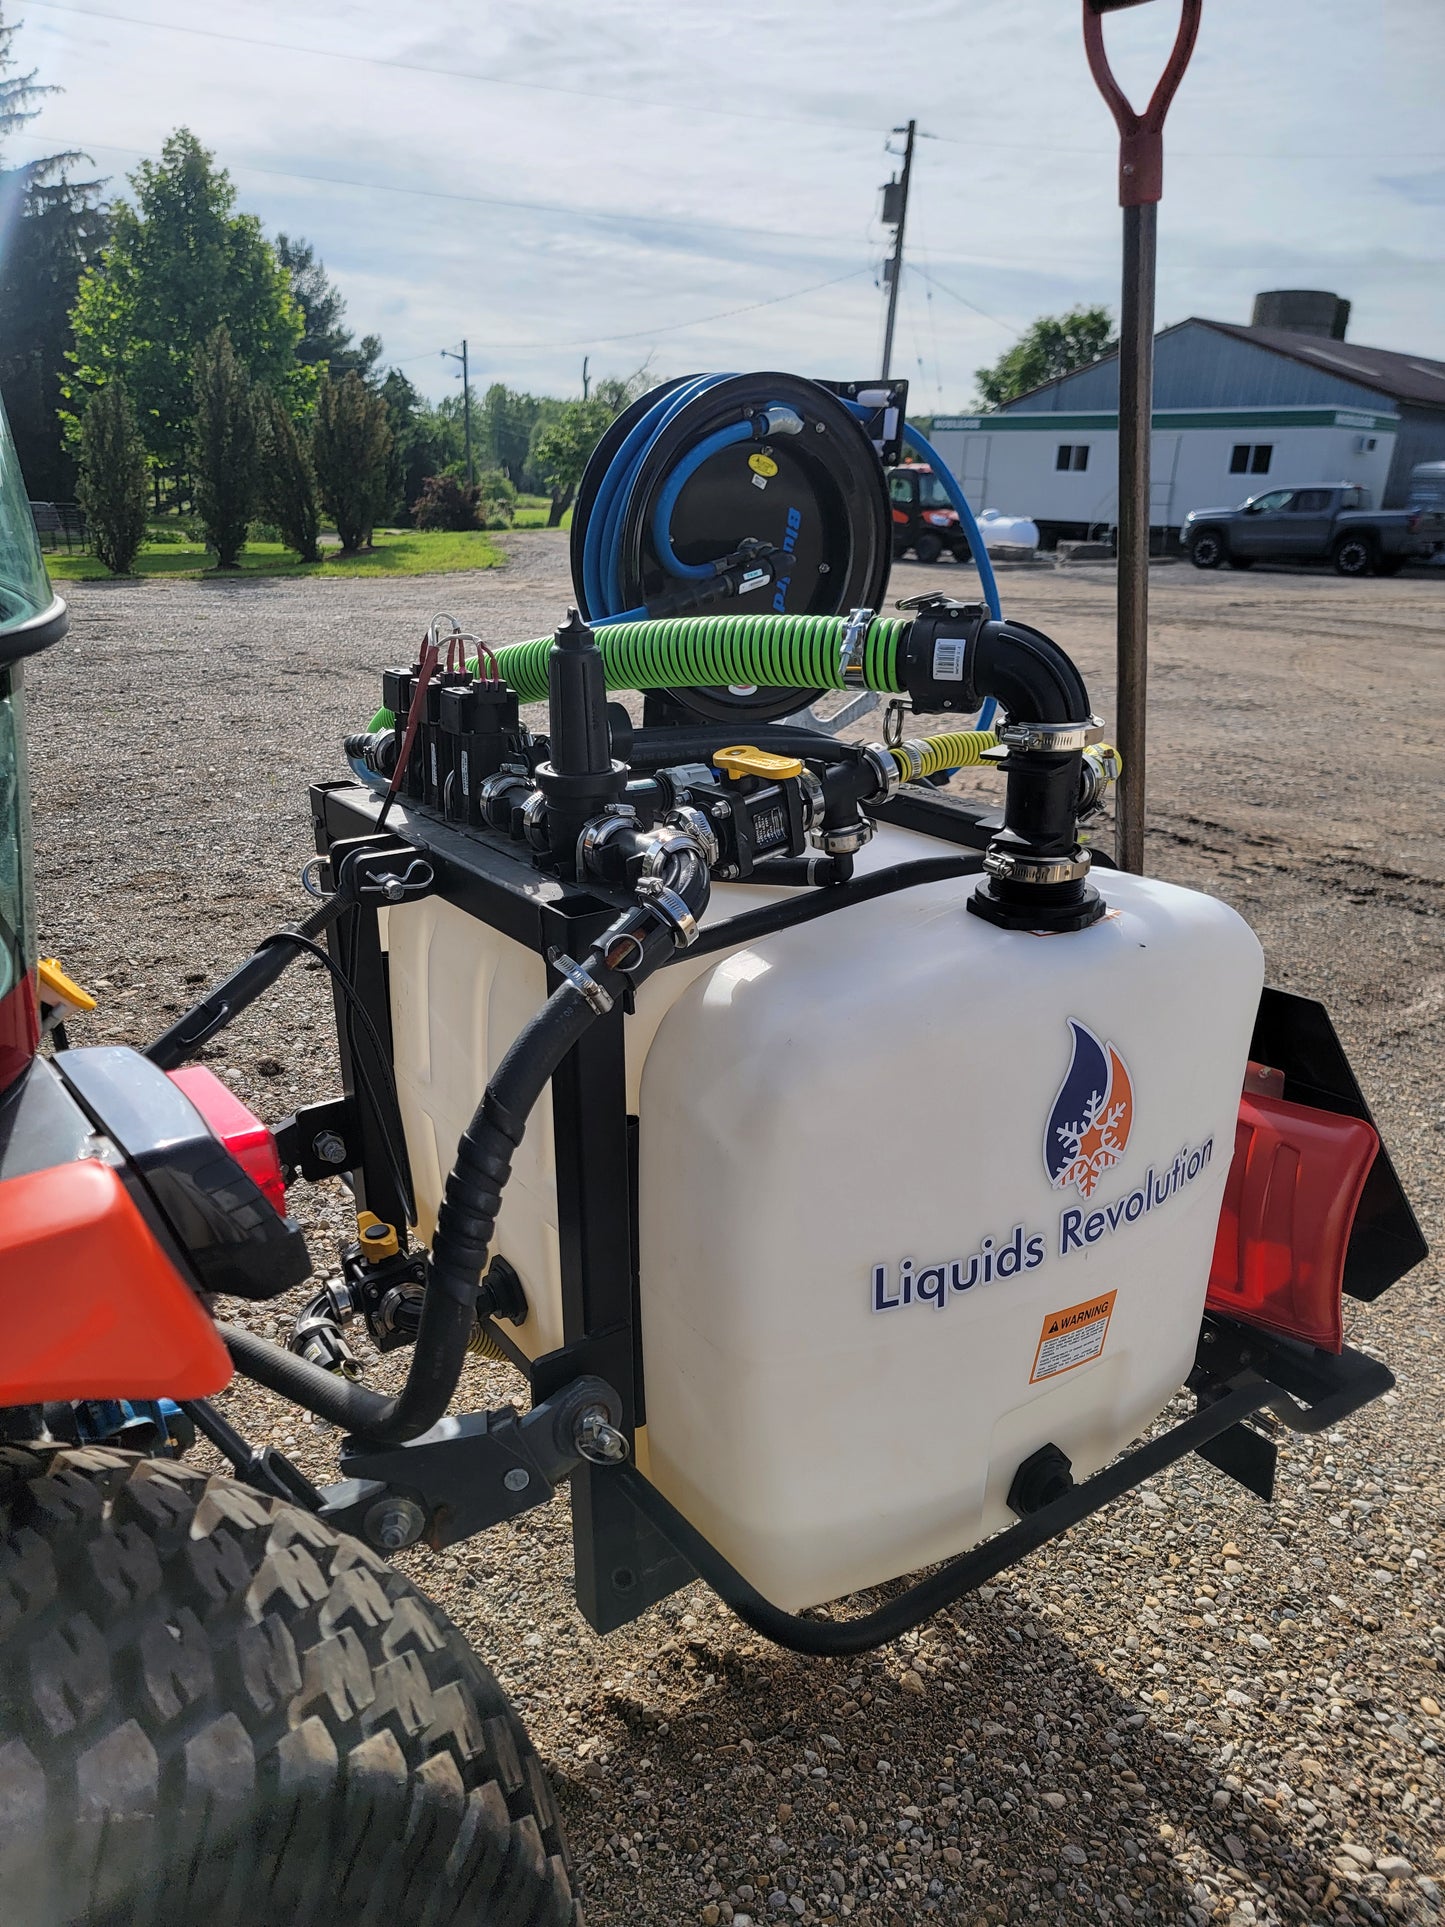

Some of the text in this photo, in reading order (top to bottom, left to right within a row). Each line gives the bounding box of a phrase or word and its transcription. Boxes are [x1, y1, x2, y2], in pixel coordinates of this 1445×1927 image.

[875, 1138, 1213, 1311] Liquids Revolution
[1060, 1301, 1109, 1330] WARNING
